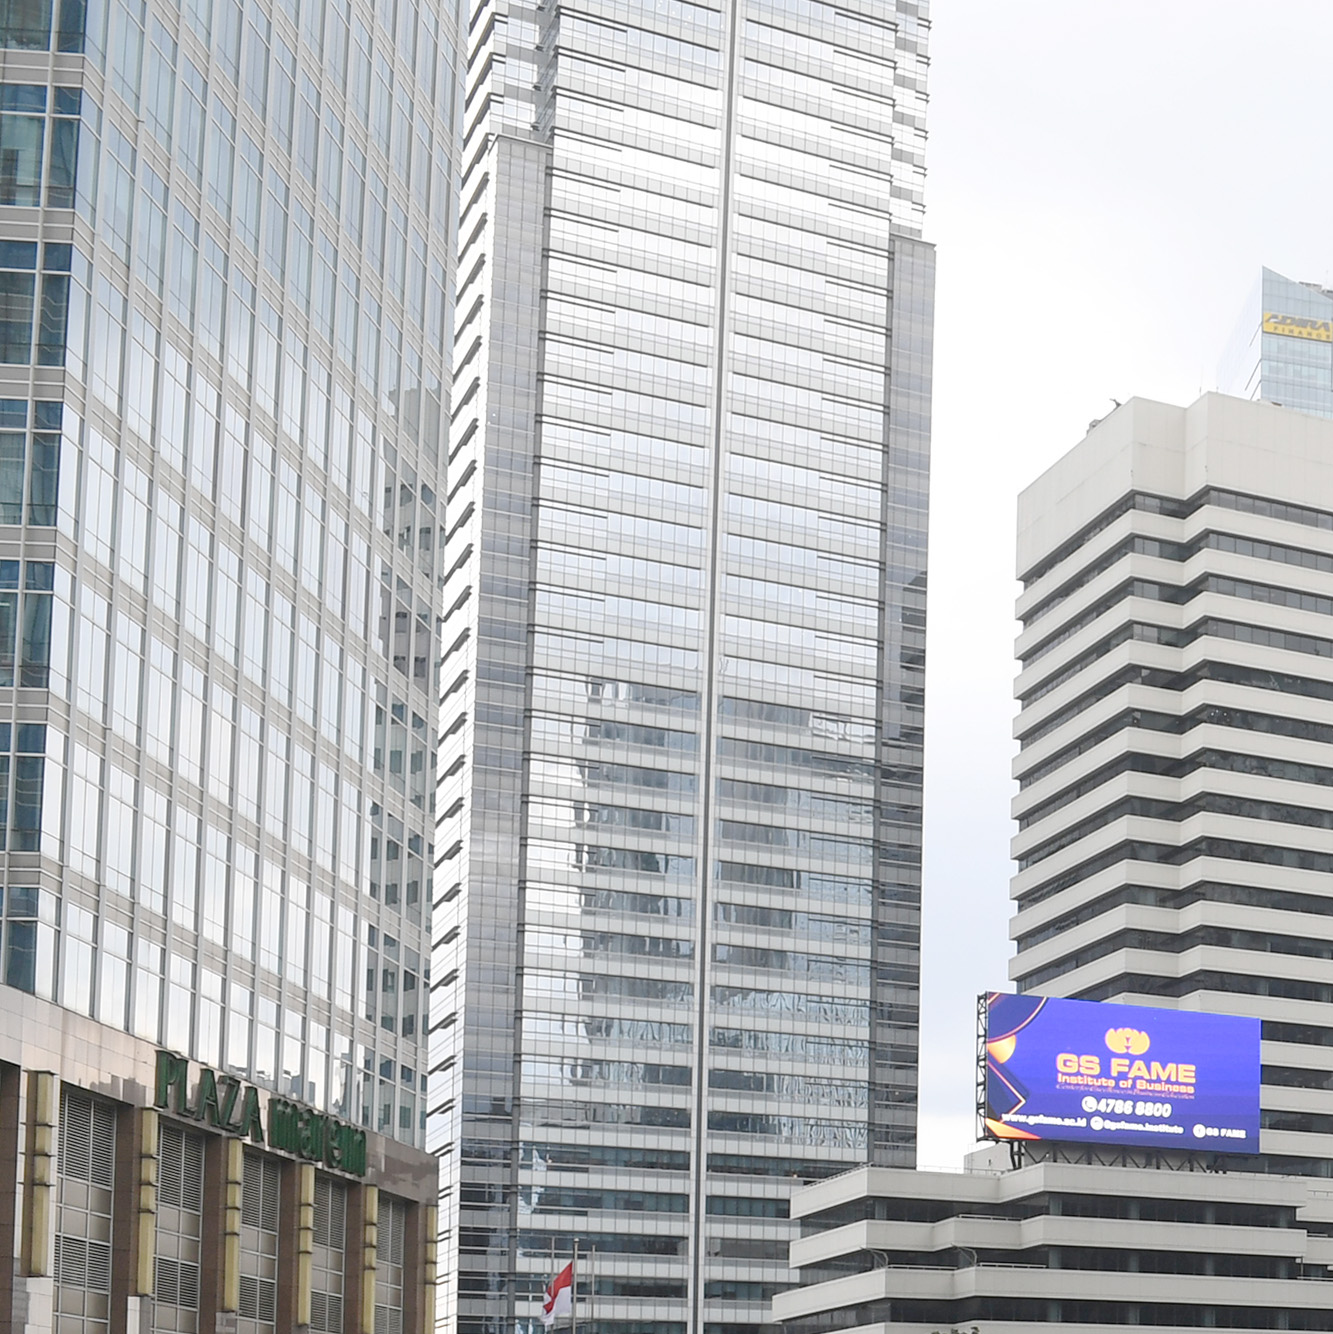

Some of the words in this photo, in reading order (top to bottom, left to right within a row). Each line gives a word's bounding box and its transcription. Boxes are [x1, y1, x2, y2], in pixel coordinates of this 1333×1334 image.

[1264, 313, 1331, 333] ADIRA
[1056, 1052, 1101, 1076] GS
[1110, 1057, 1197, 1084] FAME
[1057, 1072, 1116, 1088] Institute
[1118, 1078, 1133, 1089] of
[1135, 1078, 1195, 1094] Business
[154, 1049, 265, 1143] PLAZA
[1097, 1097, 1134, 1115] 4786
[1134, 1100, 1172, 1118] 8800
